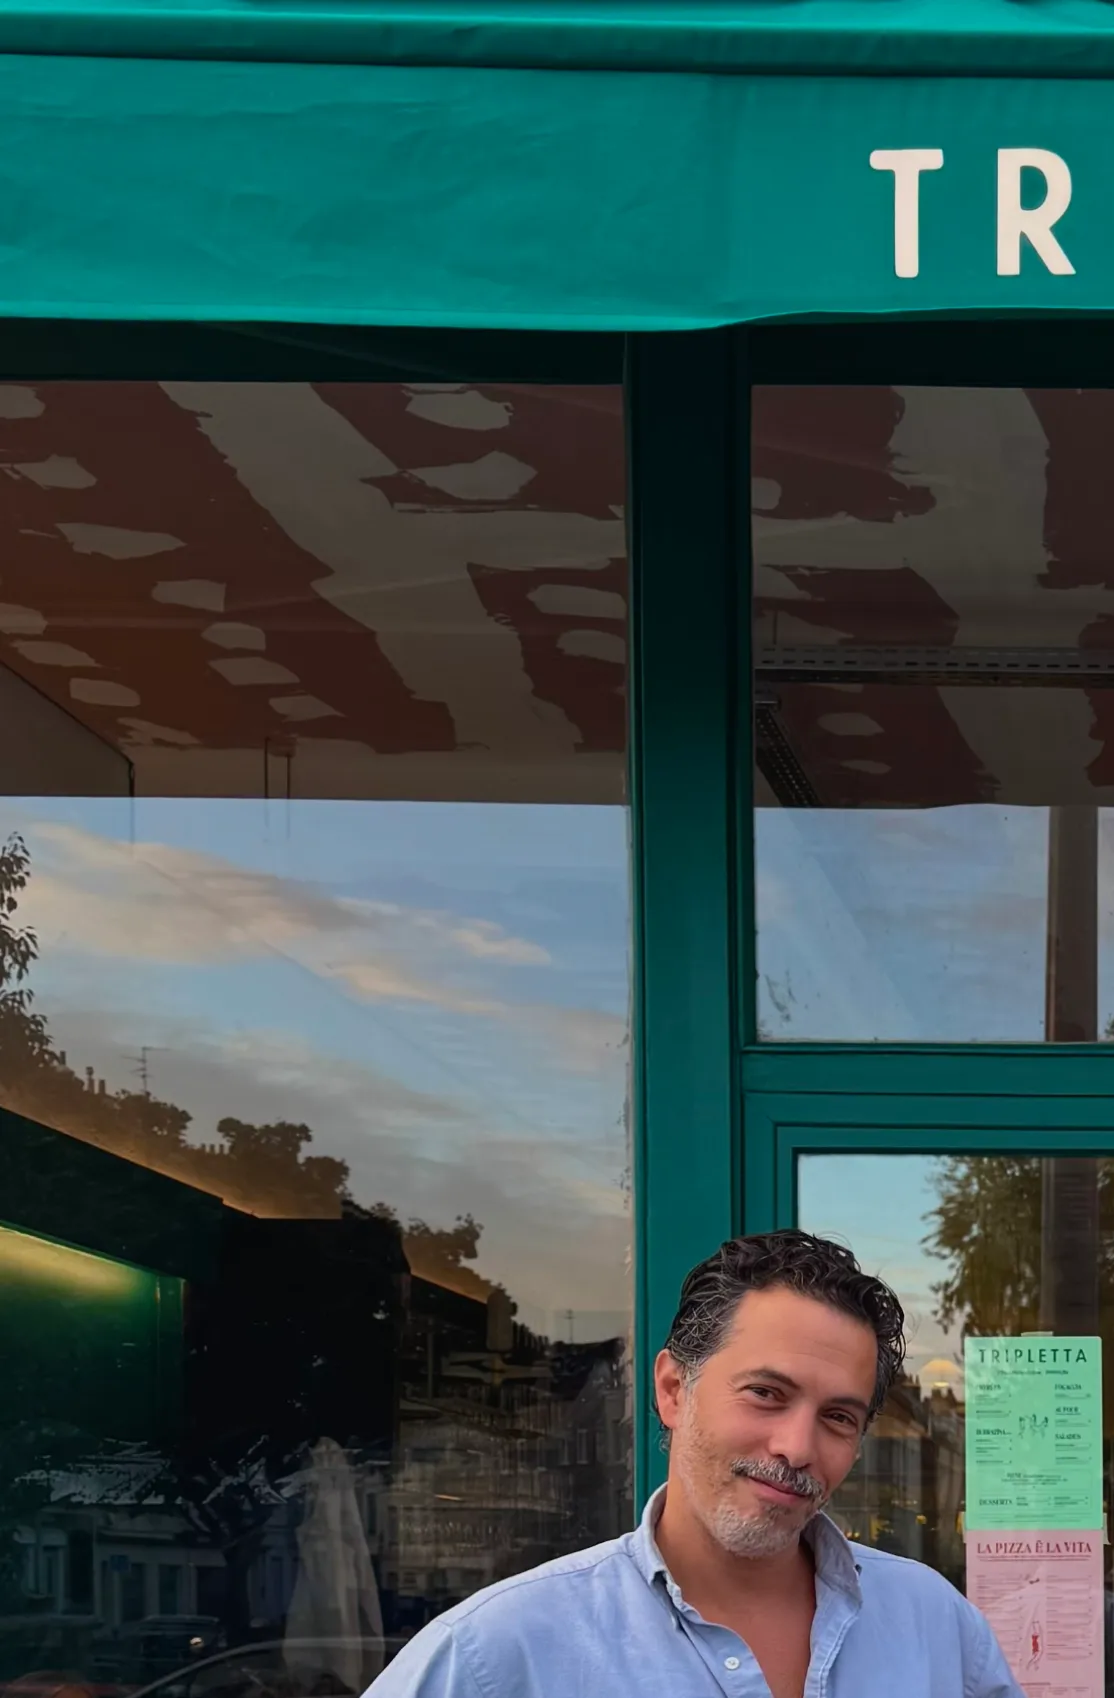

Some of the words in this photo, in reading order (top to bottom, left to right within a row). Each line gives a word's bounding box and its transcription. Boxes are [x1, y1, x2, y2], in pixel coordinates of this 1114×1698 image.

[979, 1348, 1087, 1363] TRIPLETTA
[977, 1542, 992, 1554] LA
[995, 1542, 1032, 1554] PIZZA
[1046, 1542, 1061, 1553] LA
[1063, 1541, 1092, 1553] VITA
